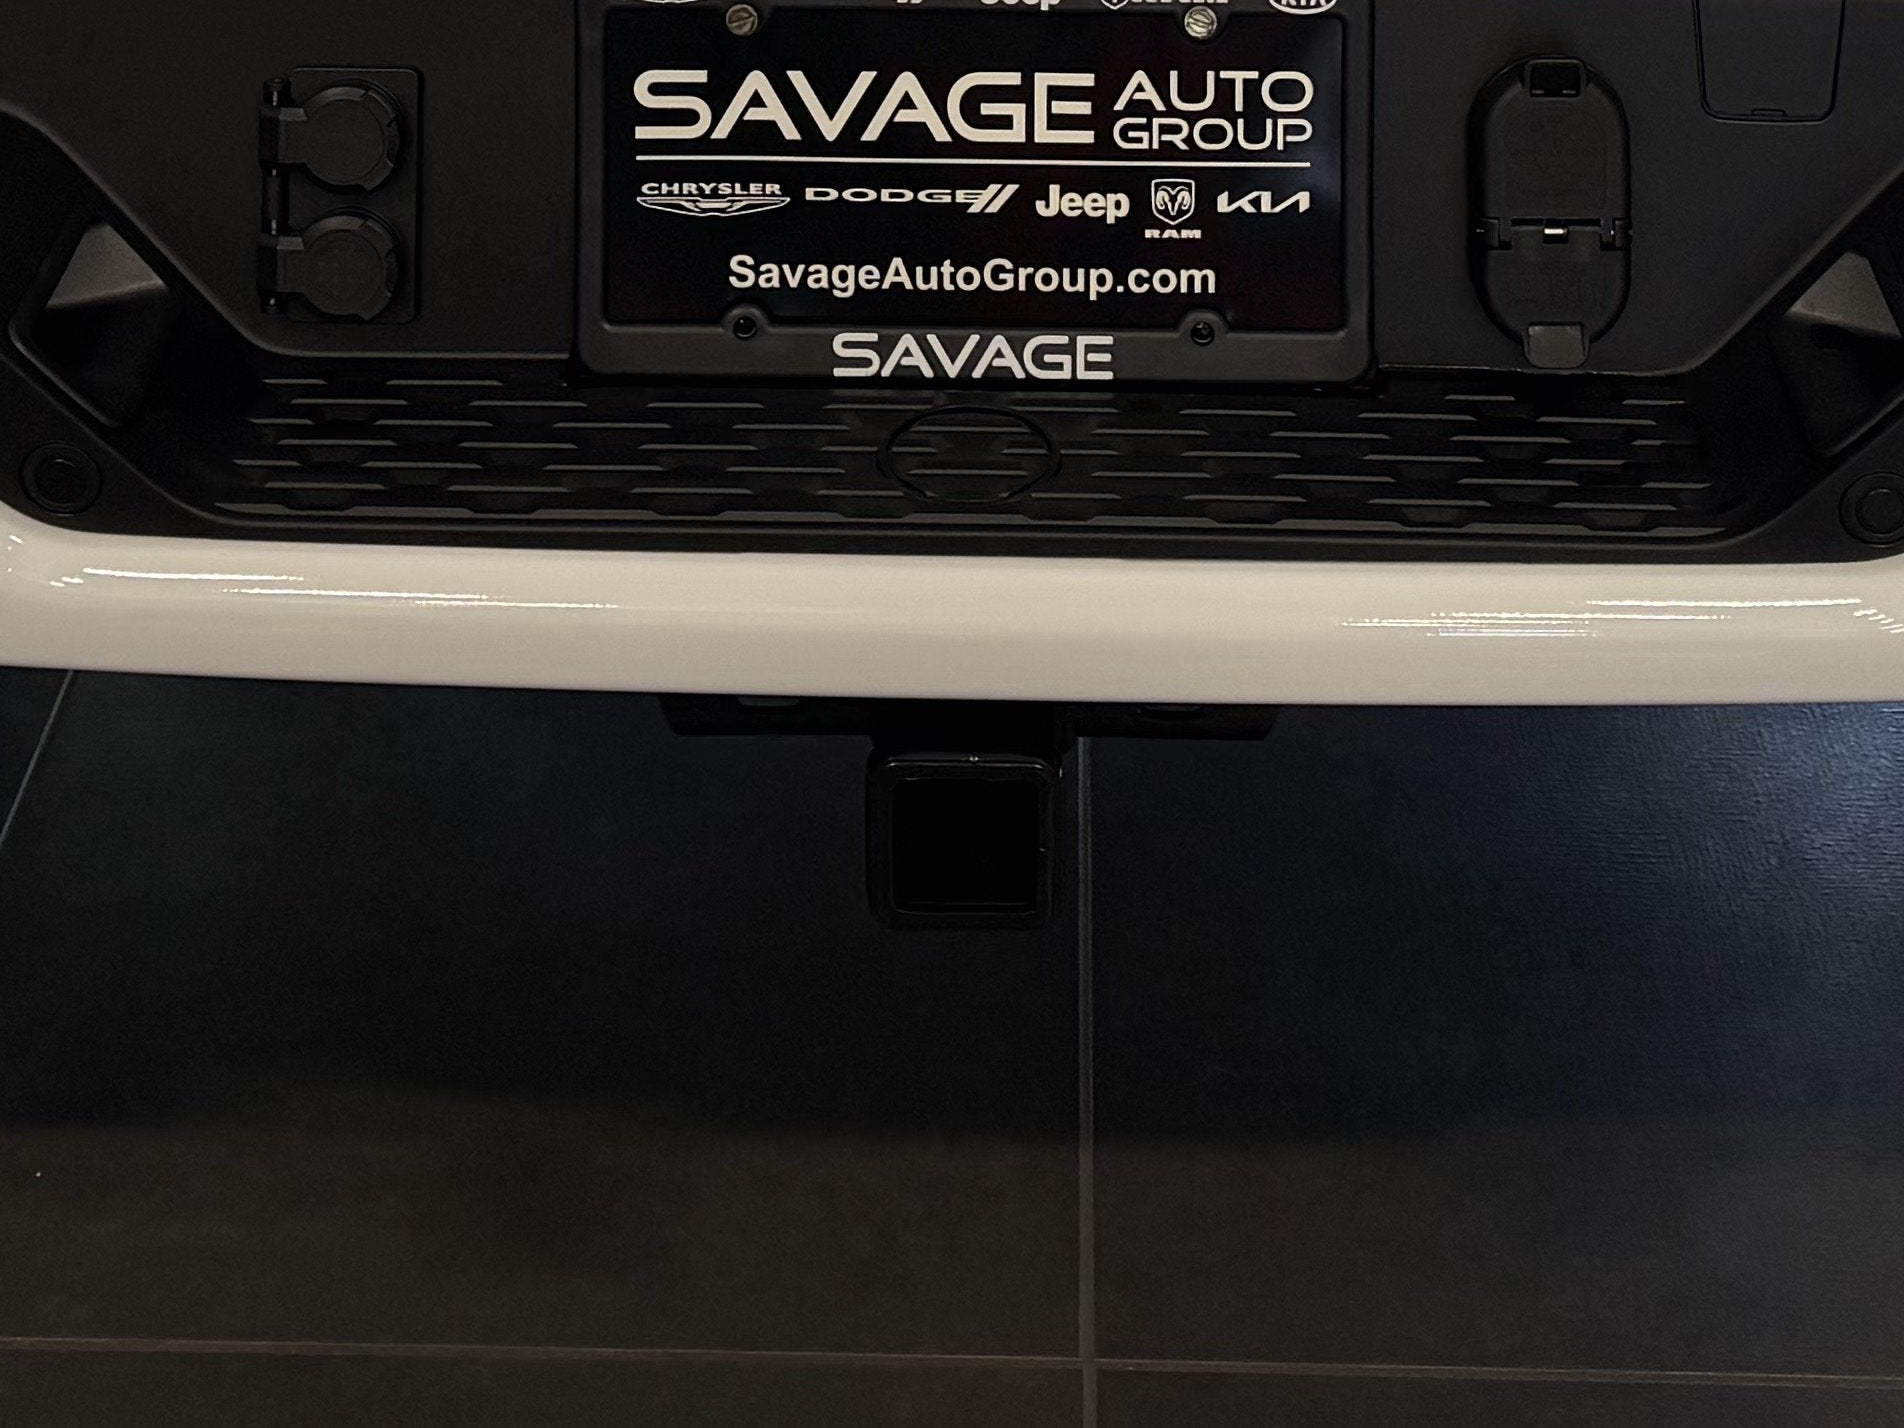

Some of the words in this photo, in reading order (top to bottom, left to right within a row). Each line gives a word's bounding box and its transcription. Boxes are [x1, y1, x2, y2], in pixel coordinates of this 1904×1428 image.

[633, 69, 1096, 144] SAVAGE
[1113, 69, 1314, 112] AUTO
[1112, 117, 1313, 151] GROUP
[641, 182, 782, 195] CHRYSLER
[805, 187, 986, 203] DODGE
[1035, 183, 1130, 225] Jeep
[1144, 228, 1202, 239] RAM
[728, 254, 1216, 301] SavageAutoGroup.com
[832, 332, 1114, 380] SAVAGE
